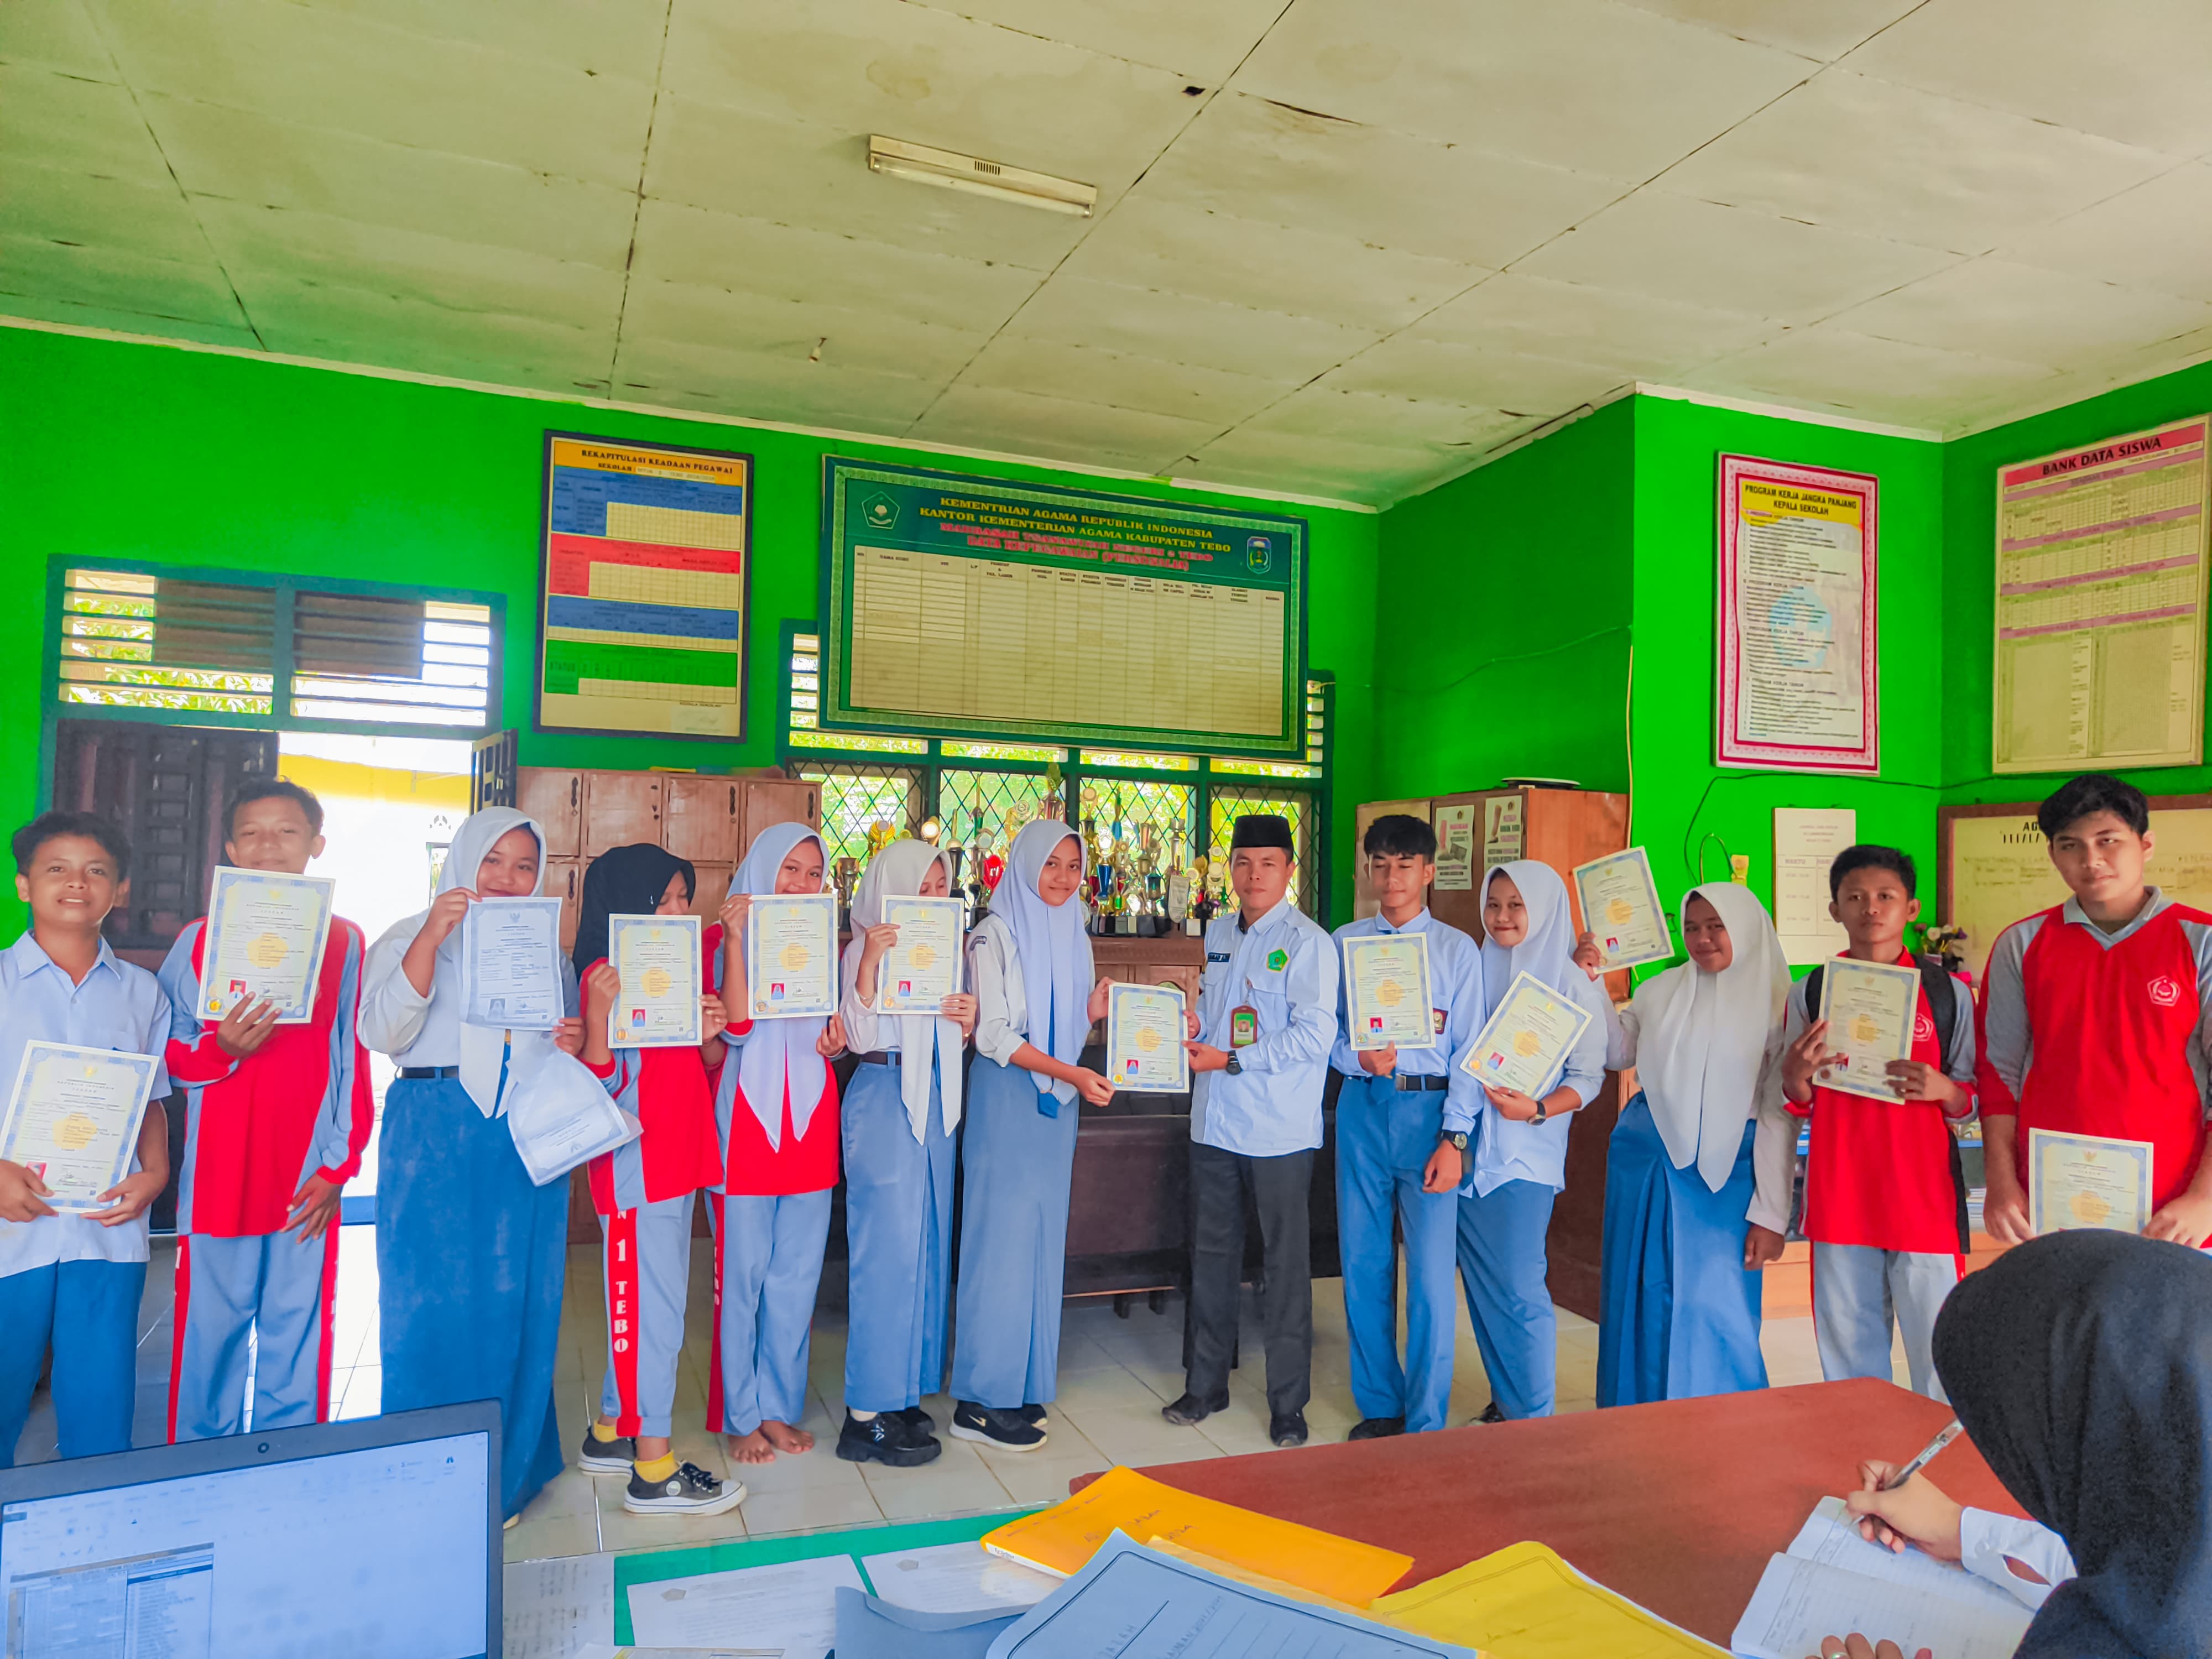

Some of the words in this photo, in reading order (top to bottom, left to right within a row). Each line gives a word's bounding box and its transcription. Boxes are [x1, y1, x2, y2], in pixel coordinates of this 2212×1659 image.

[582, 450, 646, 464] REKAPITULASI
[649, 458, 691, 469] KEADAAN
[694, 464, 733, 474] PEGAWAI
[2042, 458, 2077, 475] BANK
[2081, 449, 2115, 466] DATA
[2119, 437, 2162, 457] SISWA
[1745, 485, 1776, 496] PROGRAM
[1778, 491, 1799, 499] KERJA
[1801, 493, 1825, 504] JANGKA
[1828, 497, 1856, 509] PANJANG
[1774, 500, 1797, 510] KEPALA
[1800, 504, 1829, 515] SEKOLAH
[920, 508, 975, 521] KANTOR
[979, 515, 1075, 534] KEMENTERIAN
[1079, 528, 1122, 540] AGAMA
[1126, 533, 1196, 548] KABUPATEN
[1199, 541, 1231, 552] TEBO
[940, 498, 1030, 516] KEMENTRIAN
[1033, 509, 1077, 521] AGAMA
[1081, 515, 1144, 530] REPUBLIK
[1147, 524, 1213, 539] INDONESIA
[968, 535, 1001, 549] DATA
[1102, 551, 1189, 572] (PERSONALIA)
[617, 1239, 626, 1261] 1
[614, 1281, 629, 1353] TEBO
